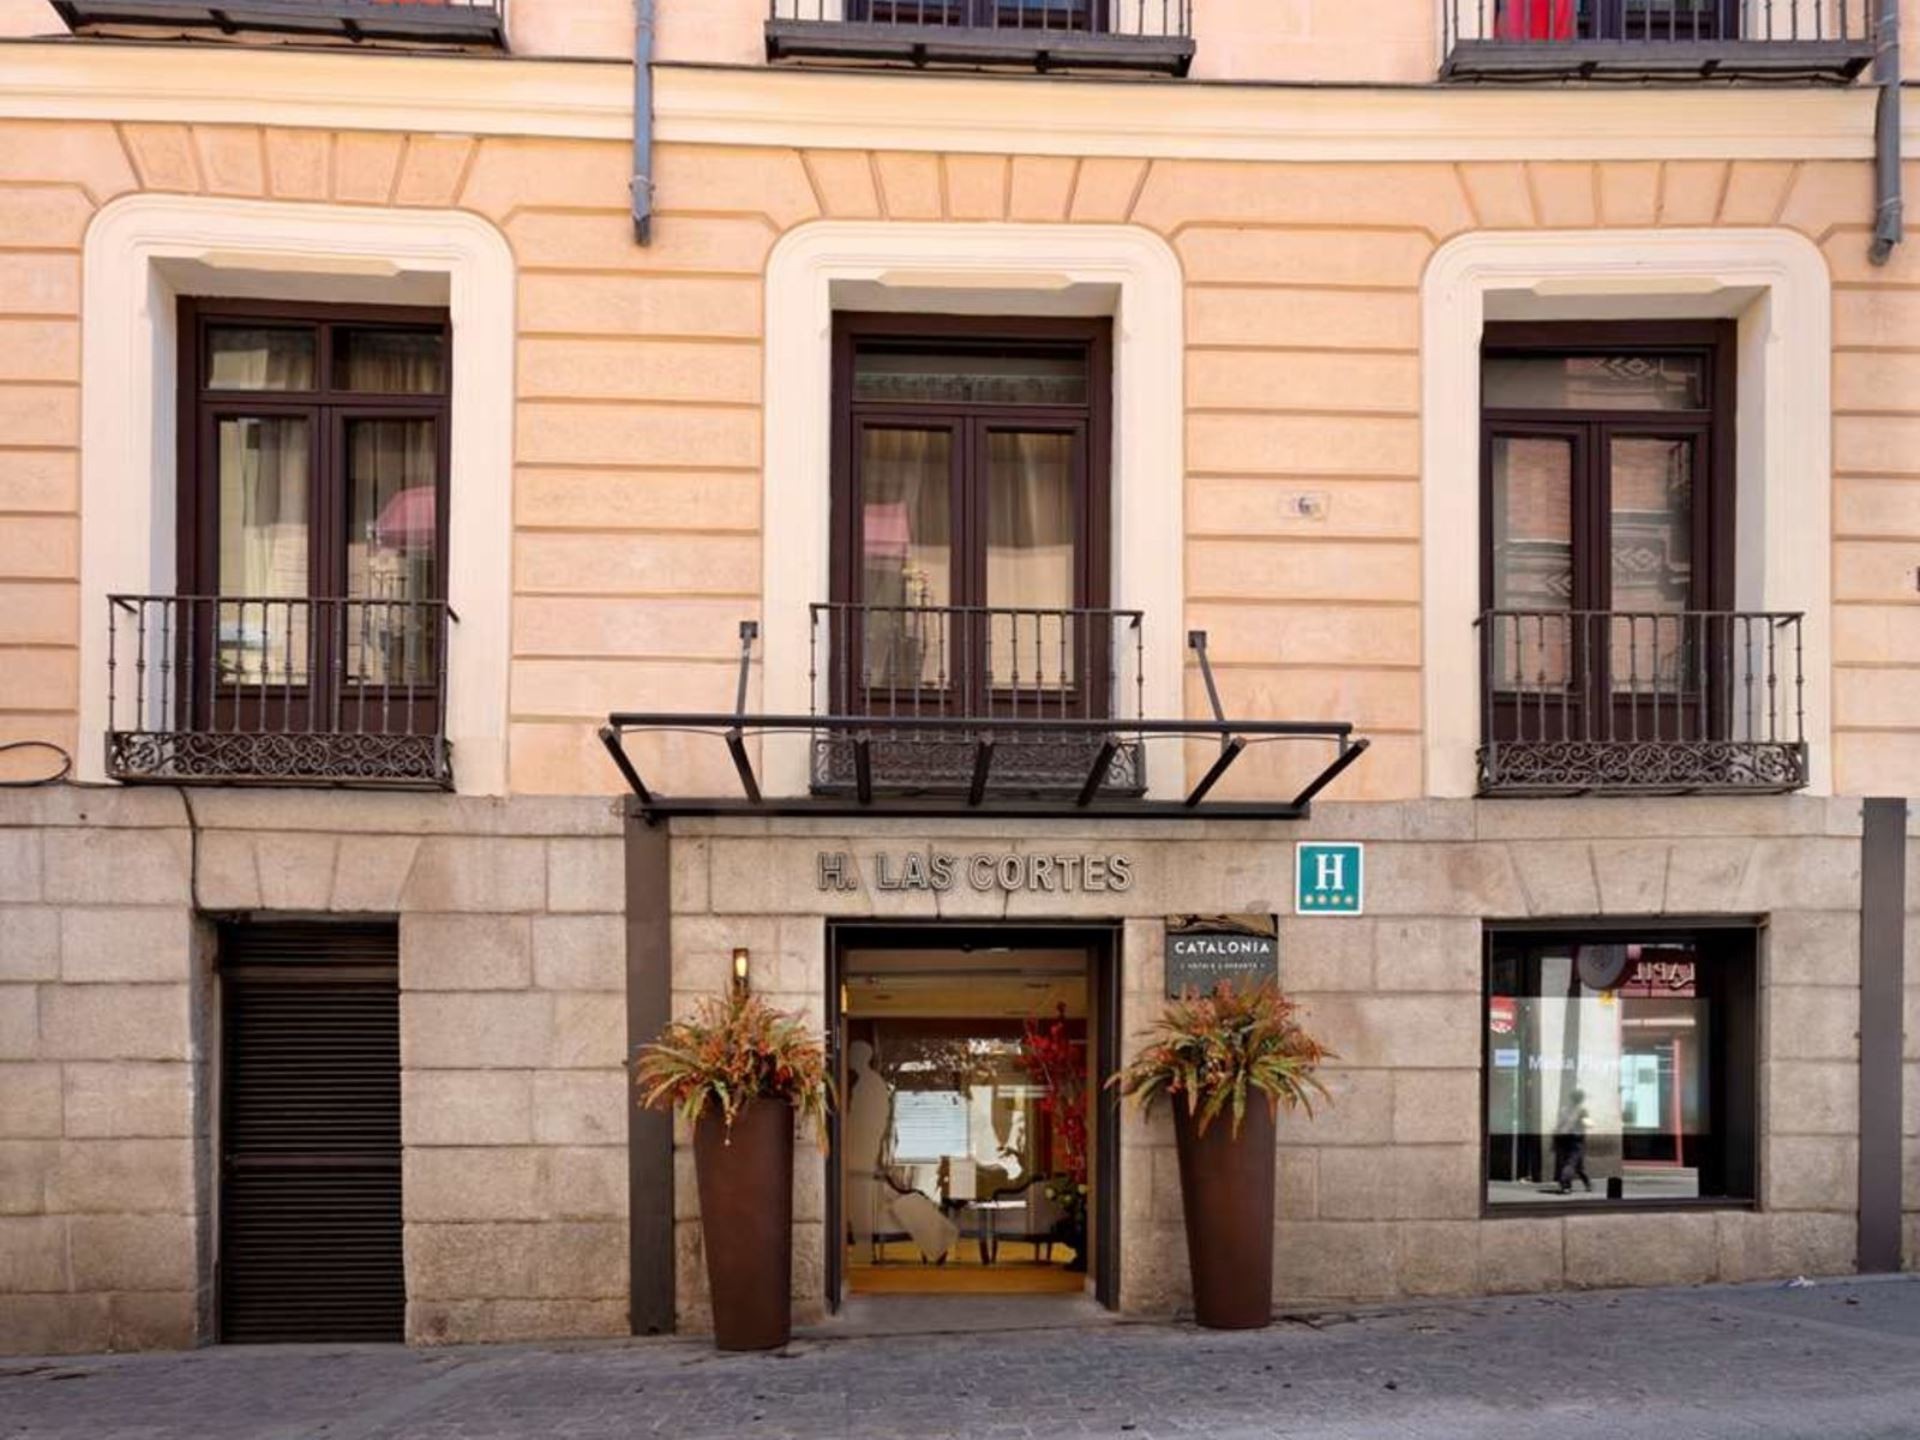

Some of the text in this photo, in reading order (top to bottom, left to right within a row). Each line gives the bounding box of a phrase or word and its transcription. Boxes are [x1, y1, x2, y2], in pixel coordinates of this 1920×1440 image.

[817, 852, 1134, 892] H. LAS CORTES
[1315, 853, 1346, 891] H
[1174, 941, 1270, 955] CATALONIA
